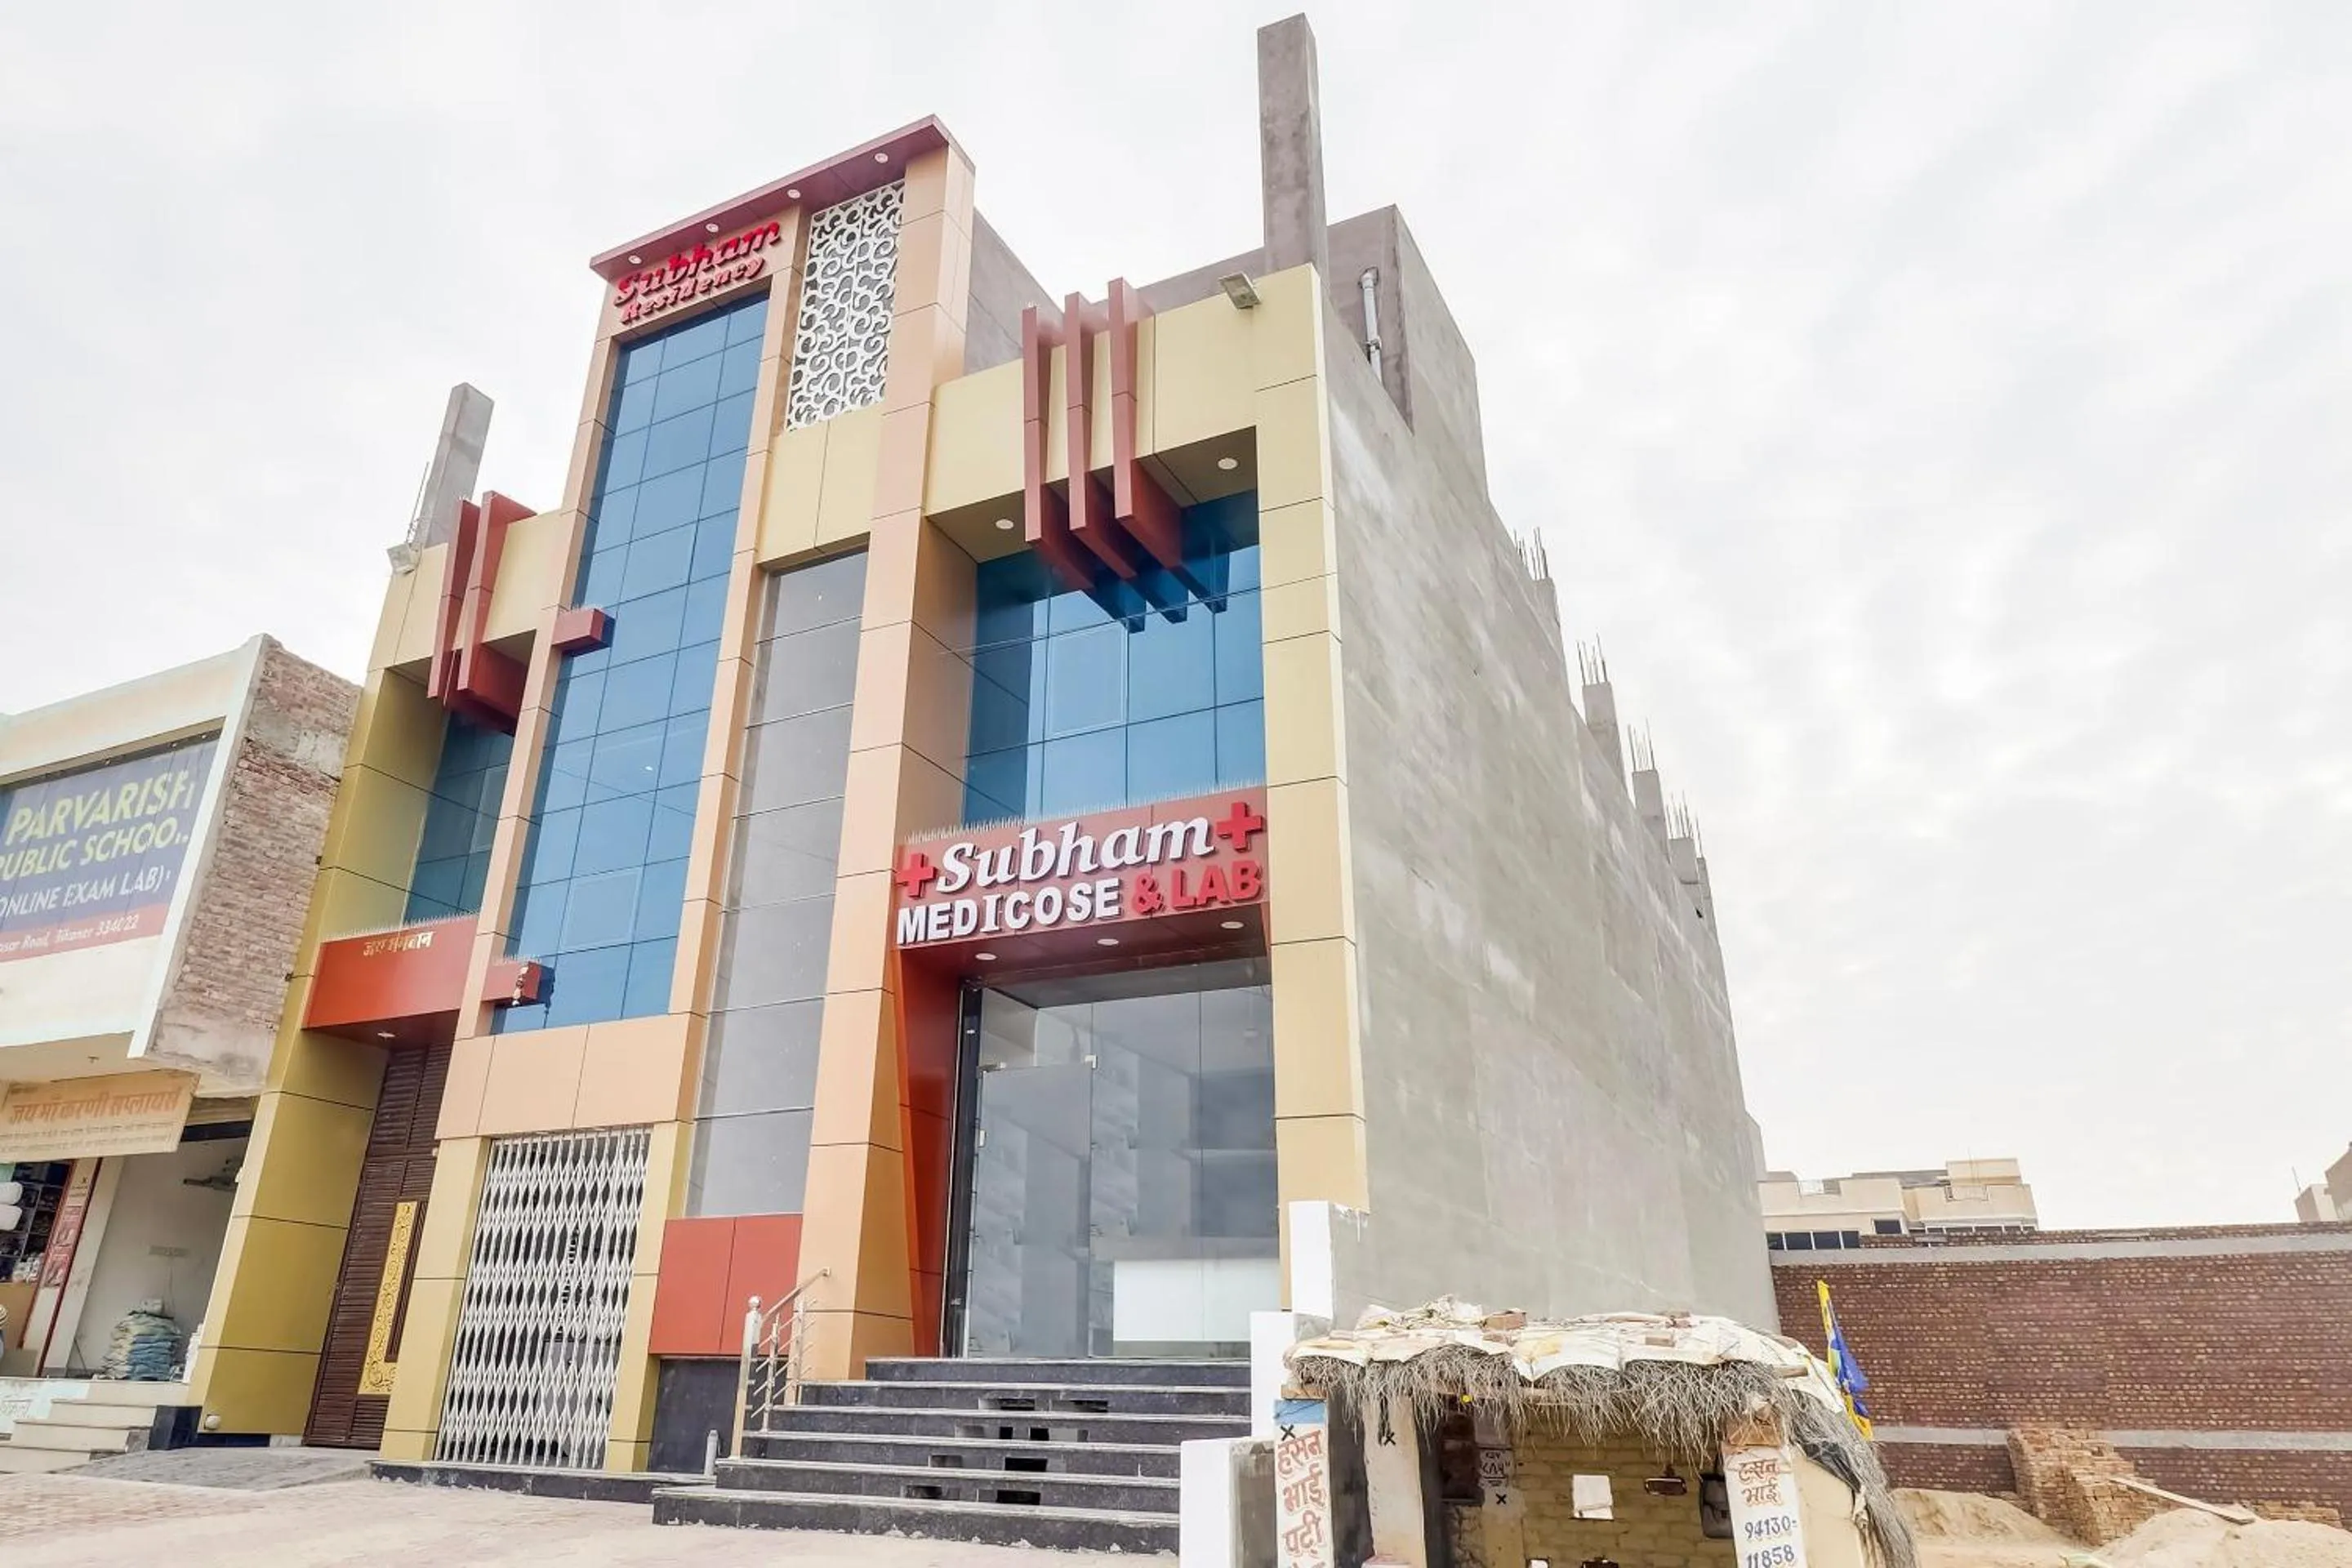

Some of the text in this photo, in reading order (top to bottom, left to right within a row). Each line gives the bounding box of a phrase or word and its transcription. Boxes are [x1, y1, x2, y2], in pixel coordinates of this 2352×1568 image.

[614, 222, 781, 306] Subham
[621, 258, 765, 325] Residency
[63, 874, 116, 906] EXAM
[935, 816, 1216, 893] Subham
[897, 860, 1261, 944] MEDICOSE & LAB
[1747, 1544, 1794, 1568] 11858
